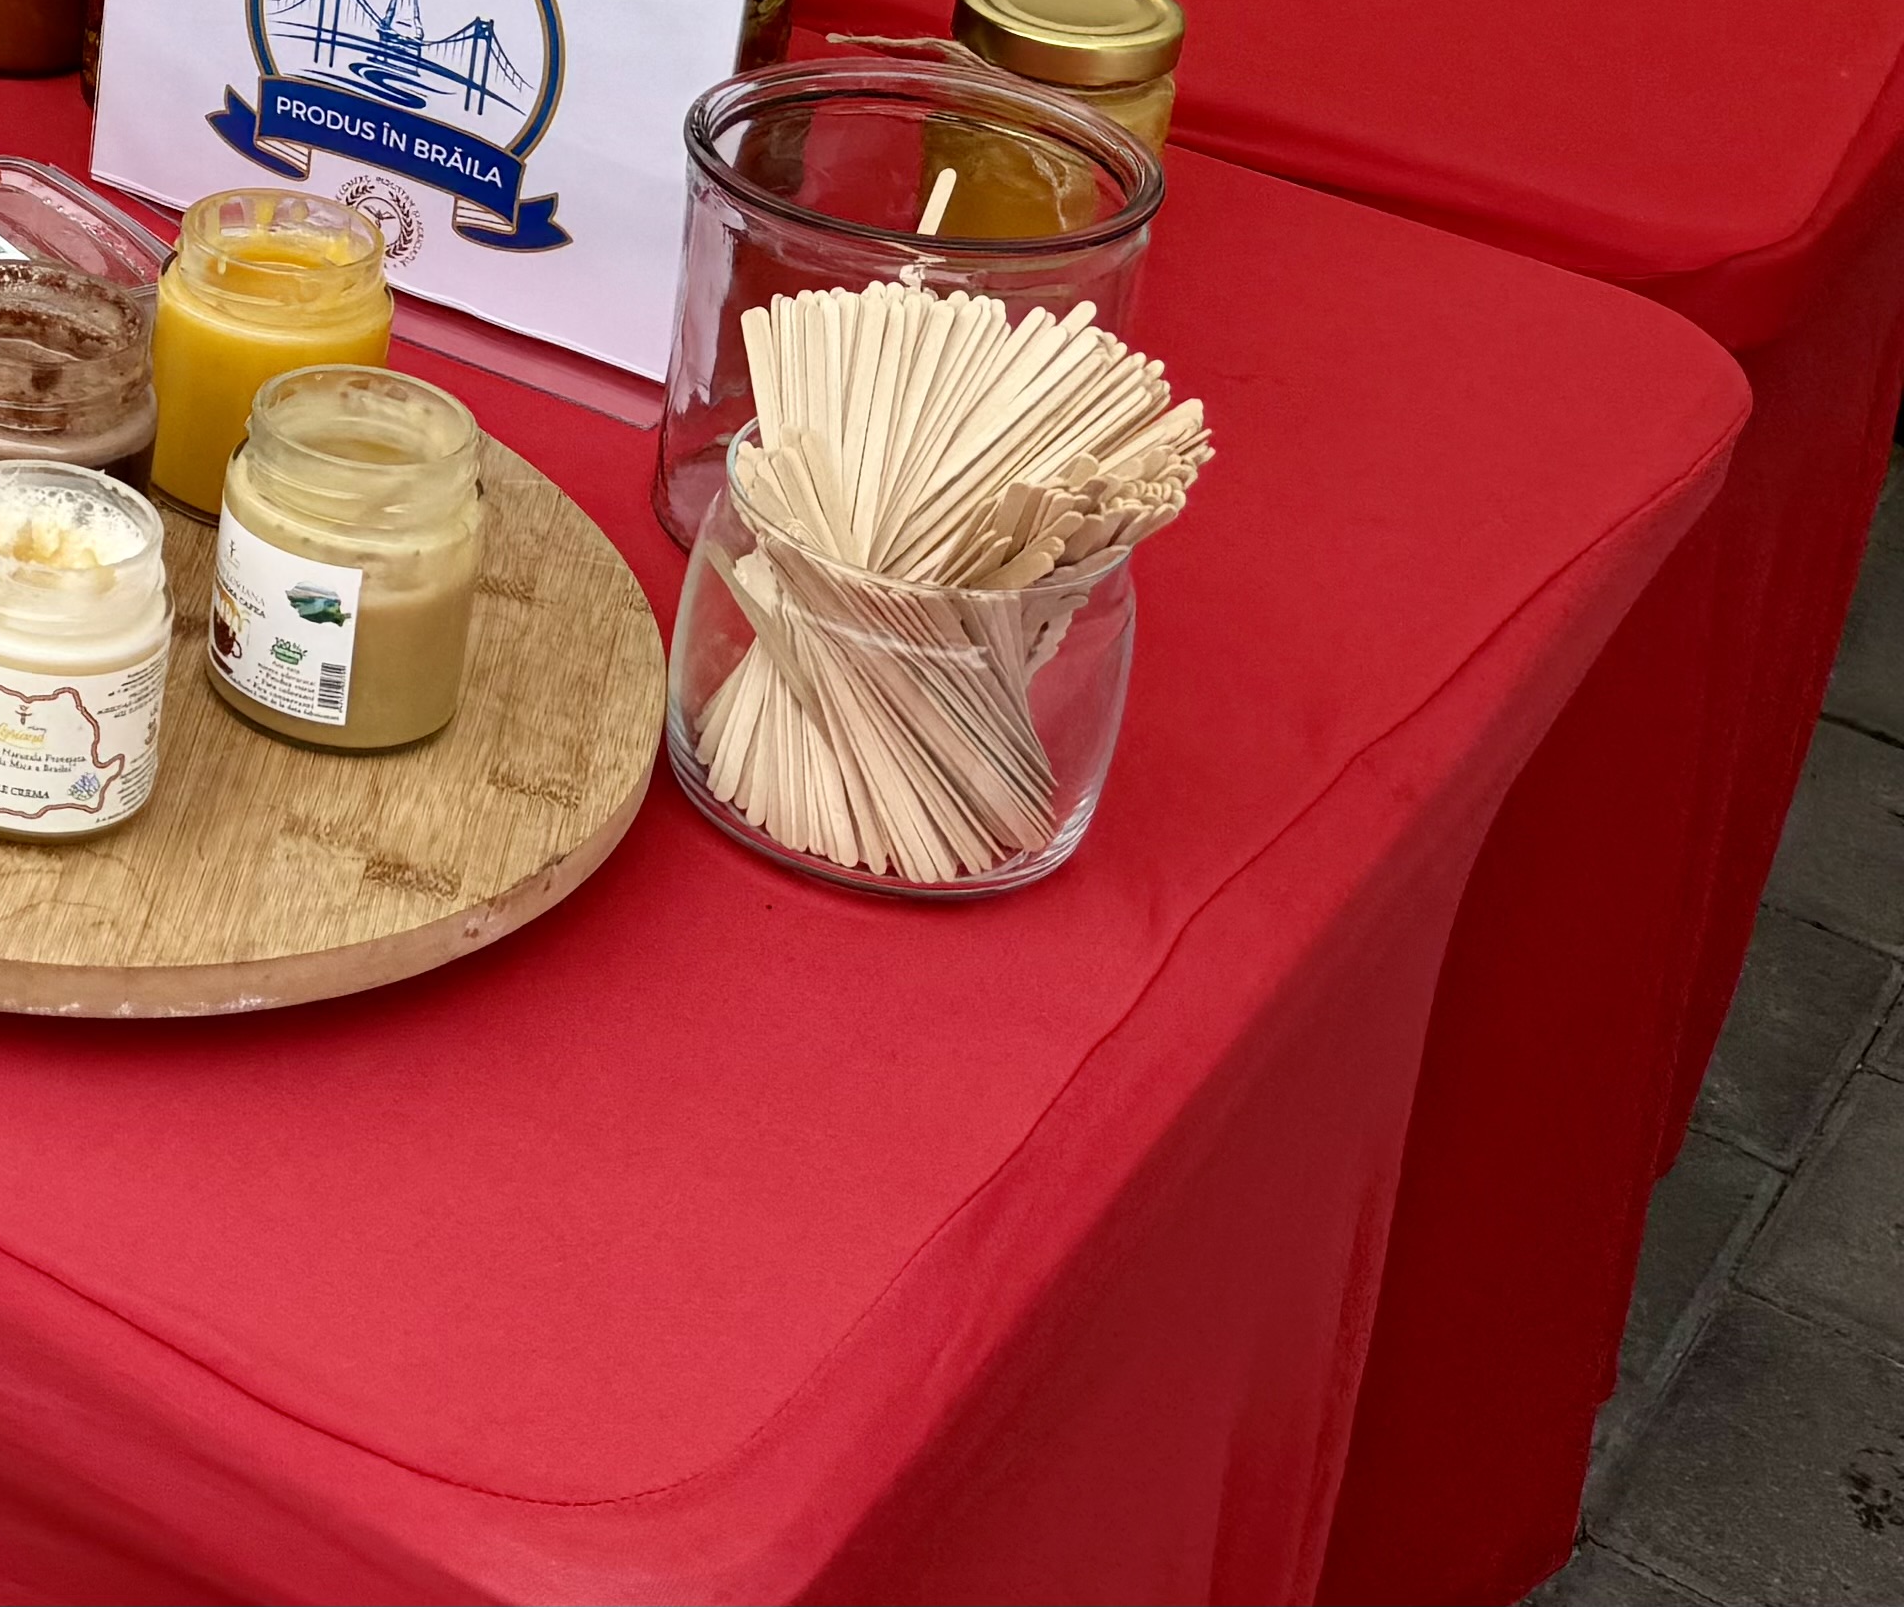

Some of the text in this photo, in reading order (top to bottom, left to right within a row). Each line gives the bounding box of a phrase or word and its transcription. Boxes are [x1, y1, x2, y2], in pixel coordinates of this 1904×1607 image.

[274, 95, 503, 189] PRODUS ÎN BRĂILA
[10, 785, 52, 801] CREMA
